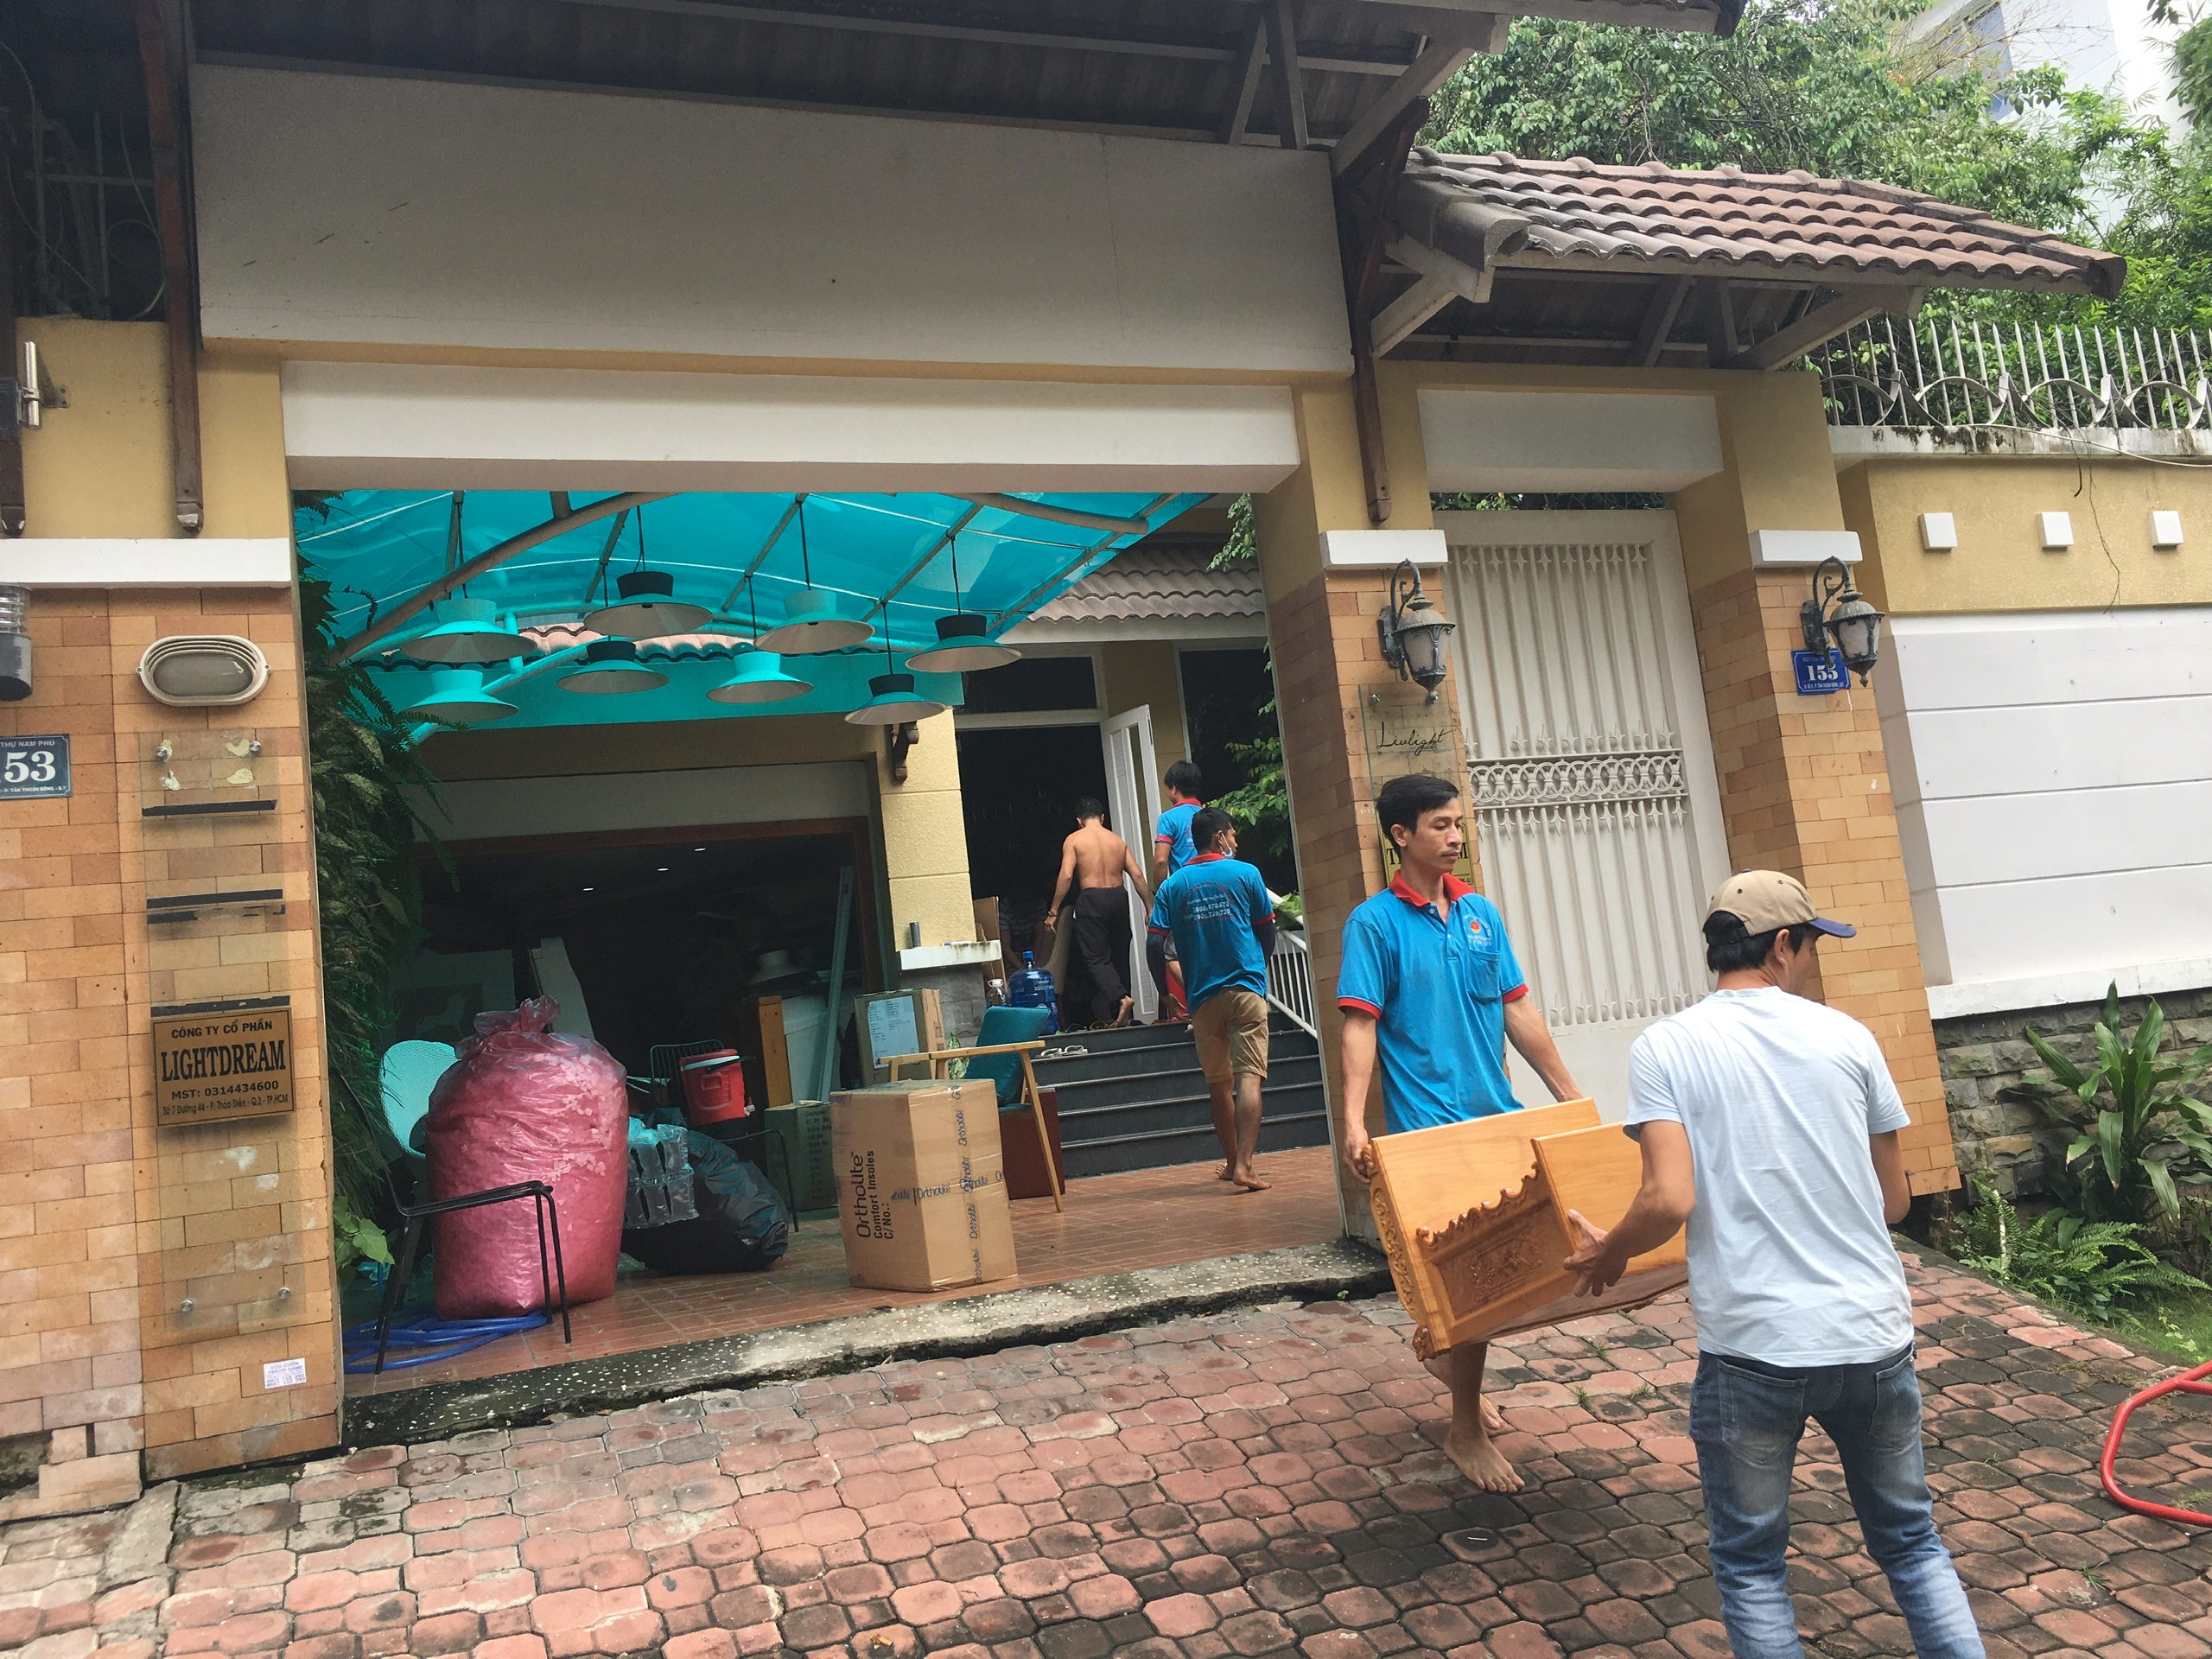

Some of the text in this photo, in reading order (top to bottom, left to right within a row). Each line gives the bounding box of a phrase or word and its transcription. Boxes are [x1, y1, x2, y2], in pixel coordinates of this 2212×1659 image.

[1807, 664, 1839, 681] 155
[0, 750, 56, 783] 53
[171, 1018, 272, 1039] CÔNG TY CỔ PHẦN
[161, 1039, 286, 1082] LIGHTDREAM
[172, 1080, 279, 1100] MST: 0314434600
[866, 1150, 883, 1239] Comfort Insoles
